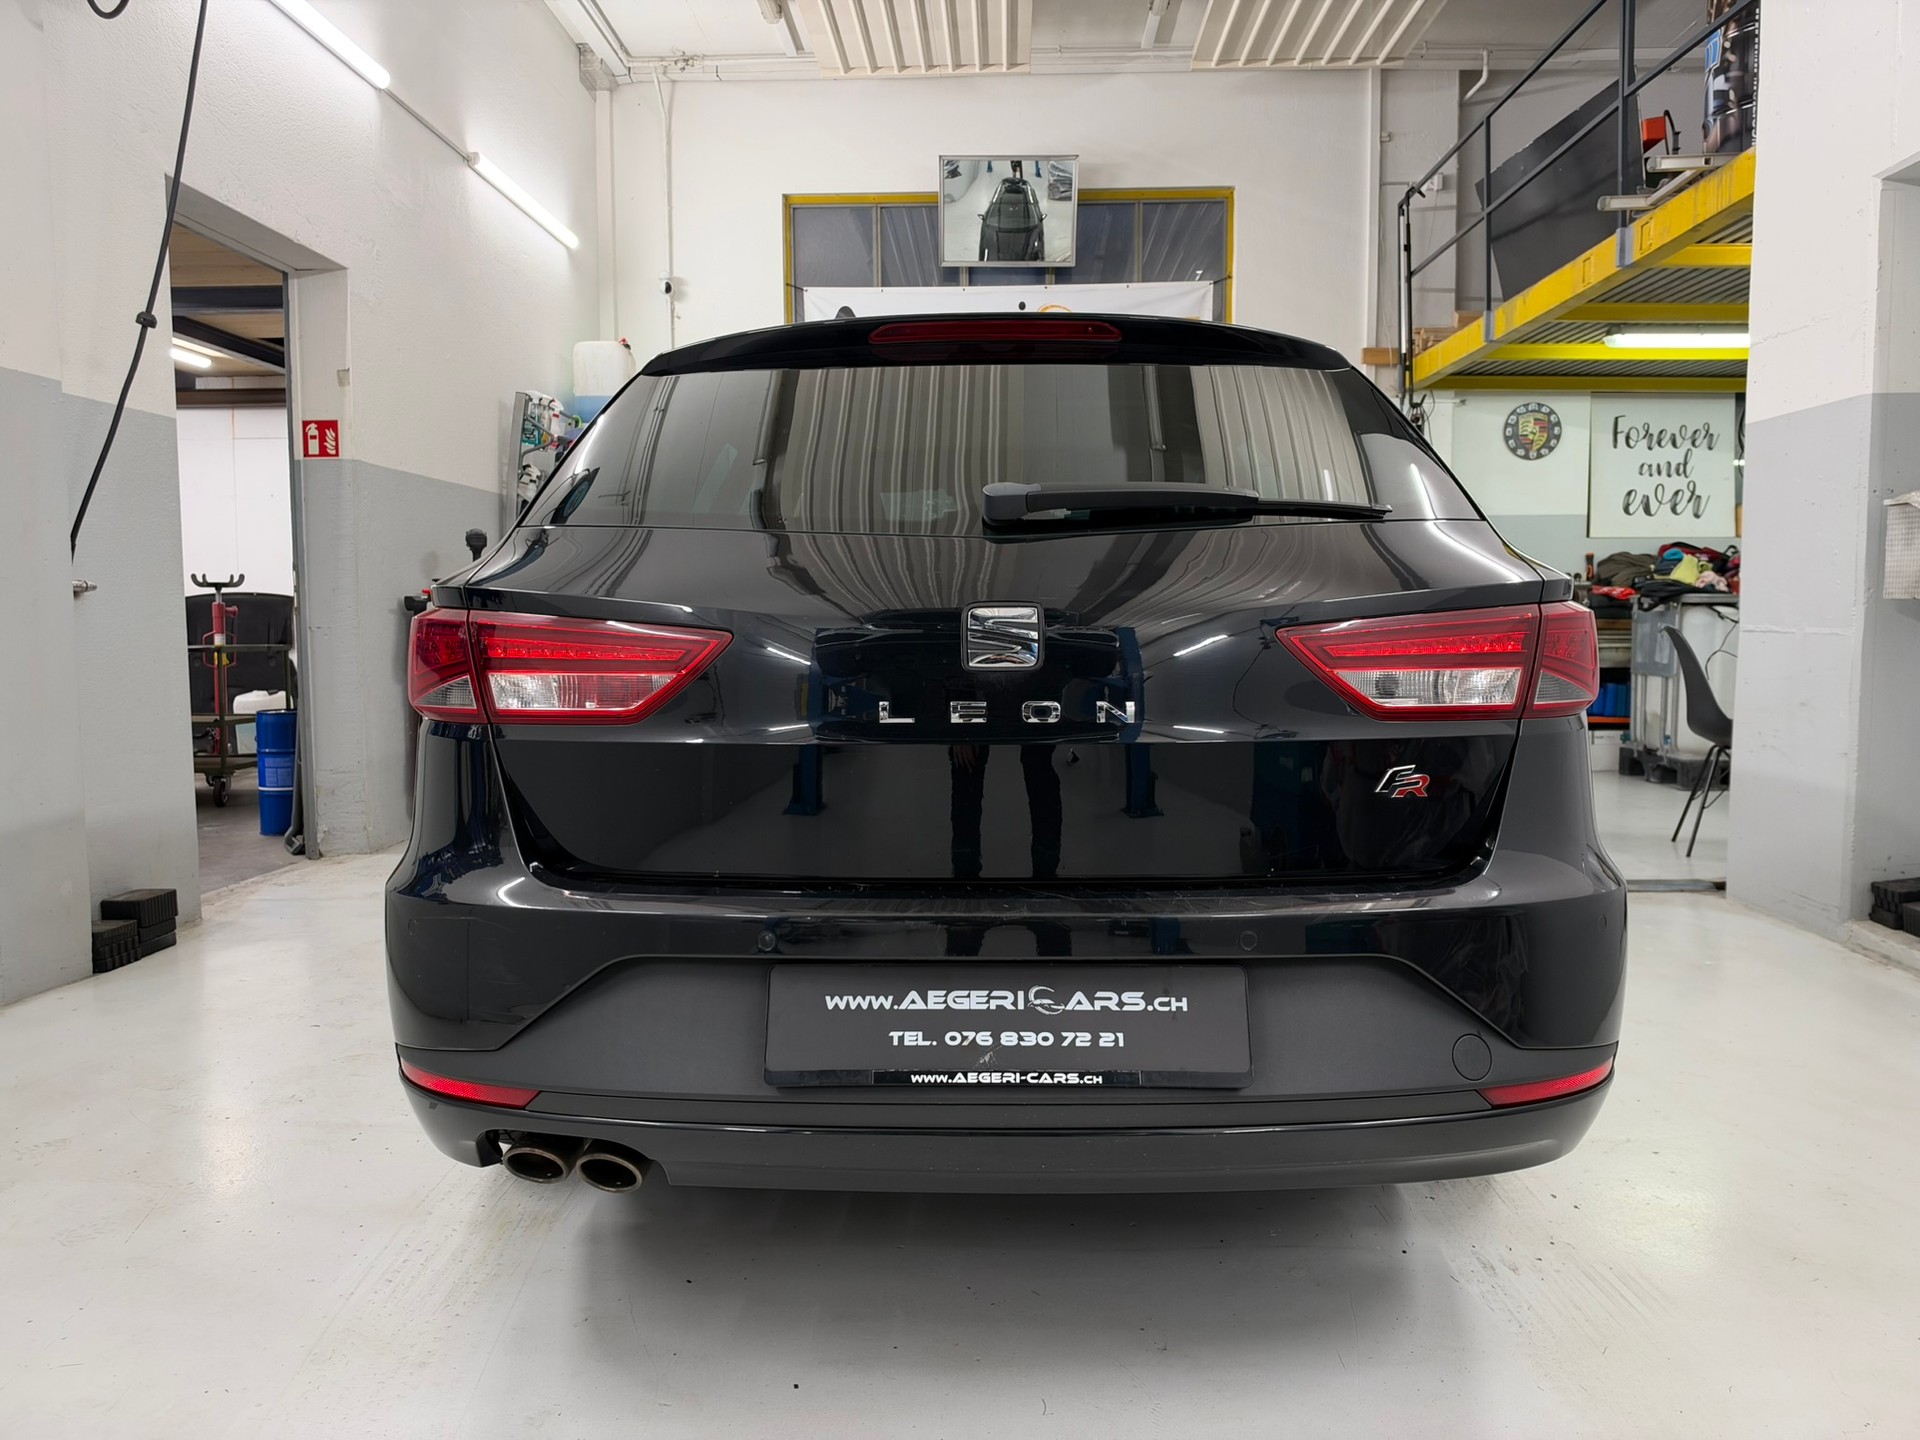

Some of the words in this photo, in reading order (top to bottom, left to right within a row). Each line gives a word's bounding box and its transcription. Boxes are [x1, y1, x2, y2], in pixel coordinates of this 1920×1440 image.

[1612, 414, 1720, 451] Forever
[1638, 448, 1694, 479] and
[1622, 479, 1711, 519] ever
[879, 701, 1135, 723] LEON
[1375, 764, 1430, 798] FR
[888, 1031, 937, 1046] TEL.
[944, 1031, 994, 1046] 076
[1000, 1031, 1055, 1046] 830
[1061, 1032, 1092, 1047] 72
[1098, 1032, 1124, 1047] 21
